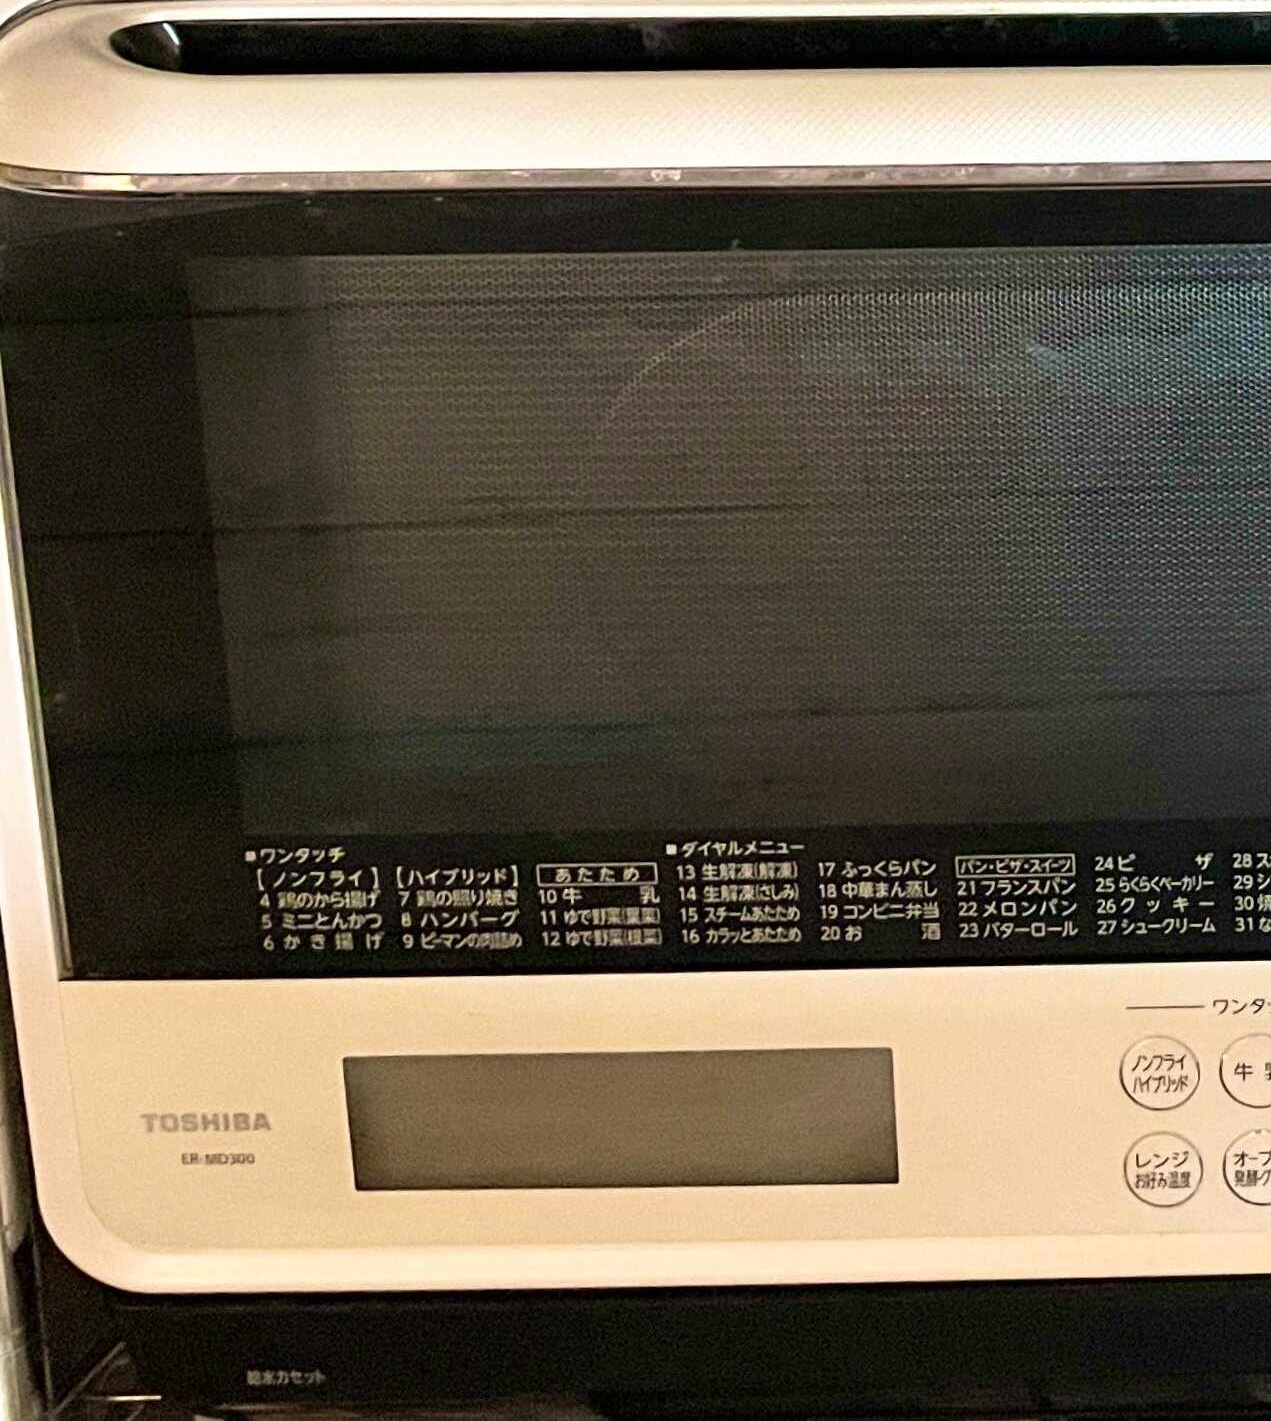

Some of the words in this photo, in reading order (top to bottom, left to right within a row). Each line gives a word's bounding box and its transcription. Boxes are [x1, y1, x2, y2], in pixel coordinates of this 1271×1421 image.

[260, 847, 346, 864] ワンタッチ
[681, 840, 805, 858] ダイヤルメニュー
[818, 862, 836, 877] 17
[840, 858, 937, 878] ふっくらパン
[1094, 855, 1114, 871] 24
[1232, 852, 1253, 868] 28
[555, 867, 640, 883] あたため
[677, 864, 696, 880] 13
[957, 880, 976, 896] 21
[980, 877, 1076, 896] フランスパン
[1095, 876, 1115, 892] 25
[1119, 874, 1215, 893] らくらくベーカリー
[1233, 874, 1254, 889] 29
[398, 891, 410, 906] 7
[539, 889, 557, 904] 10
[679, 885, 697, 901] 14
[819, 883, 837, 898] 18
[260, 893, 270, 907] 4
[958, 901, 978, 917] 22
[982, 898, 1078, 917] メロンパン
[1096, 898, 1117, 914] 26
[1120, 896, 1215, 914] クッキー
[1234, 895, 1255, 911] 30
[541, 909, 557, 925] 11
[680, 907, 698, 923] 15
[703, 905, 801, 923] スチームあたため
[820, 904, 838, 919] 19
[843, 900, 940, 919] コンビニ弁当
[262, 914, 272, 929] 5
[282, 912, 382, 930] ミニとんかつ
[401, 912, 412, 927] 8
[420, 909, 520, 928] ハンバーグ
[1097, 919, 1118, 935] 27
[1121, 917, 1216, 935] シュークリーム
[1235, 917, 1254, 932] 31
[682, 929, 700, 944] 16
[820, 925, 840, 940] 20
[959, 922, 979, 938] 23
[983, 920, 1079, 939] バターロール
[263, 935, 274, 951] 6
[402, 933, 414, 949] 9
[542, 930, 561, 946] 12
[1131, 1053, 1187, 1073] ノンフライ
[140, 1111, 273, 1133] TOSHIBA
[1135, 1150, 1190, 1169] レンジ
